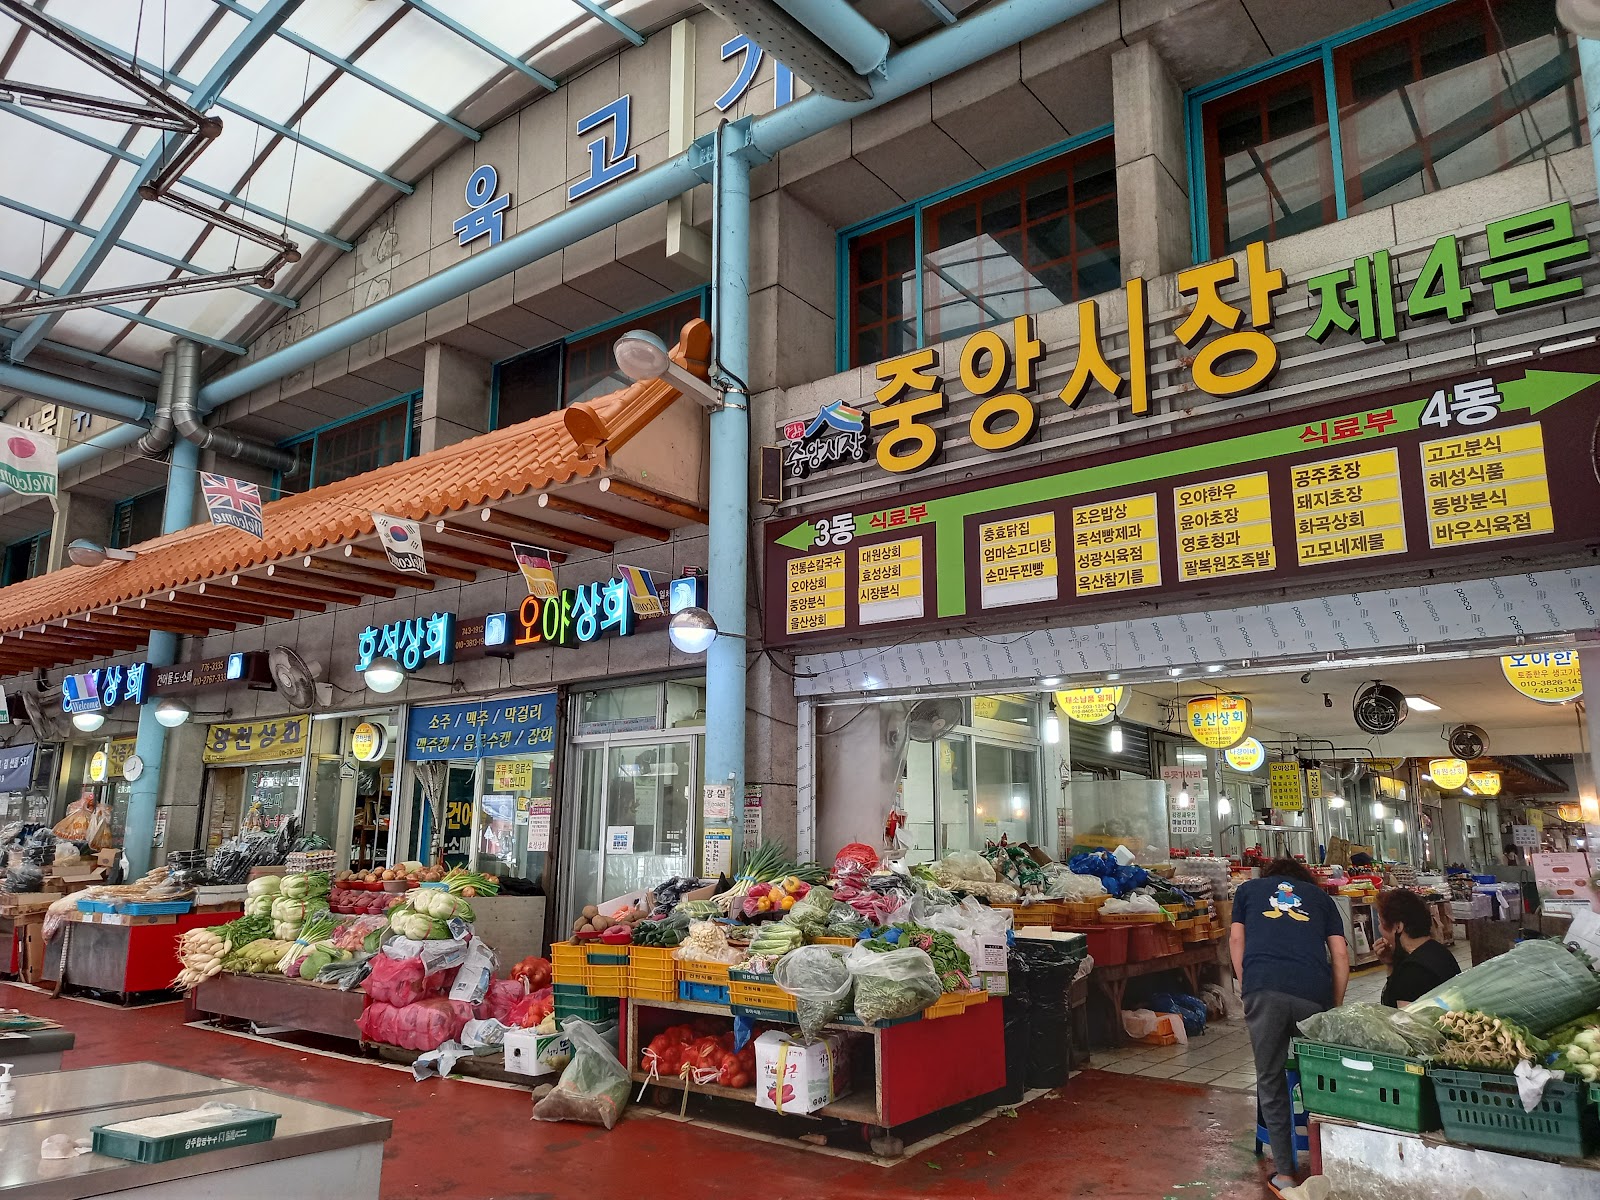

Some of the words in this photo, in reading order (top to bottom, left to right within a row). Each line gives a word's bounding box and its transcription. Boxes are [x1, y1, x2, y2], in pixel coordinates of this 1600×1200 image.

[870, 241, 1285, 474] 중앙시장
[1306, 201, 1589, 344] 제4문
[1299, 409, 1398, 444] 식료부
[1421, 376, 1502, 428] 4동
[785, 431, 866, 476] 중앙시장
[1427, 435, 1501, 463] 고고분식
[1295, 461, 1361, 488] 공주초장
[1429, 461, 1505, 488] 혜성식품
[1178, 483, 1237, 506] 오야한우
[1297, 485, 1363, 510] 돼지초장
[1432, 488, 1507, 515] 동방분식
[813, 512, 855, 547] 3동
[869, 504, 928, 529] 식료부
[1075, 503, 1128, 526] 조은밥상
[1180, 507, 1239, 530] 윤아초장
[1299, 510, 1365, 535] 화곡상회
[983, 522, 1030, 542] 충효닭집
[1076, 524, 1142, 547] 즉석빵제과
[1436, 512, 1532, 541] 바우식육점
[984, 538, 1052, 562] 엄마손고디탕
[1182, 530, 1240, 553] 영호청과
[1301, 533, 1385, 559] 고모네제물
[789, 555, 842, 576] 전통손칼국수
[862, 545, 901, 563] 대원상회
[1077, 546, 1143, 569] 성광식육점
[1184, 550, 1271, 576] 팔복원조족발
[862, 564, 901, 583] 효성상회
[985, 561, 1045, 583] 손만두찐빵
[1078, 568, 1144, 591] 옥산참기름
[790, 576, 827, 593] 오야상회
[860, 583, 900, 602] 시장분식
[789, 594, 826, 613] 중앙분식
[1423, 599, 1440, 622] posco
[1454, 587, 1472, 611] posco
[1576, 591, 1595, 616] posco
[515, 577, 628, 646] 오야상회
[790, 613, 827, 630] 울산상회
[1291, 606, 1306, 628] posco
[1393, 609, 1410, 633] posco
[1542, 602, 1560, 628] posco
[1045, 629, 1055, 647] posco
[1152, 622, 1164, 642] posco
[1239, 626, 1253, 648] posco
[1265, 616, 1279, 638] posco
[1364, 621, 1379, 644] posco
[355, 612, 448, 671] 효성상회
[935, 641, 945, 657] posco
[1024, 637, 1034, 655] posco
[1101, 642, 1111, 661] posco
[1128, 631, 1140, 651] posco
[1214, 636, 1227, 657] posco
[899, 656, 907, 673] posco
[917, 649, 926, 665] posco
[984, 653, 993, 672] posco
[1003, 645, 1014, 664] posco
[1078, 650, 1089, 669] posco
[1510, 651, 1579, 667] 오야한
[963, 661, 973, 679] posco
[1518, 670, 1548, 678] 토종한우
[72, 701, 99, 712] Welcome
[428, 714, 451, 730] 소주
[466, 710, 489, 727] 맥주
[505, 703, 542, 723] 막걸리
[1192, 711, 1243, 727] 울산상회
[213, 720, 300, 753] 영천상회
[416, 736, 450, 753] 맥주캔
[527, 726, 553, 746] 잡화
[496, 764, 507, 775] 주류
[515, 763, 531, 774] 음료수
